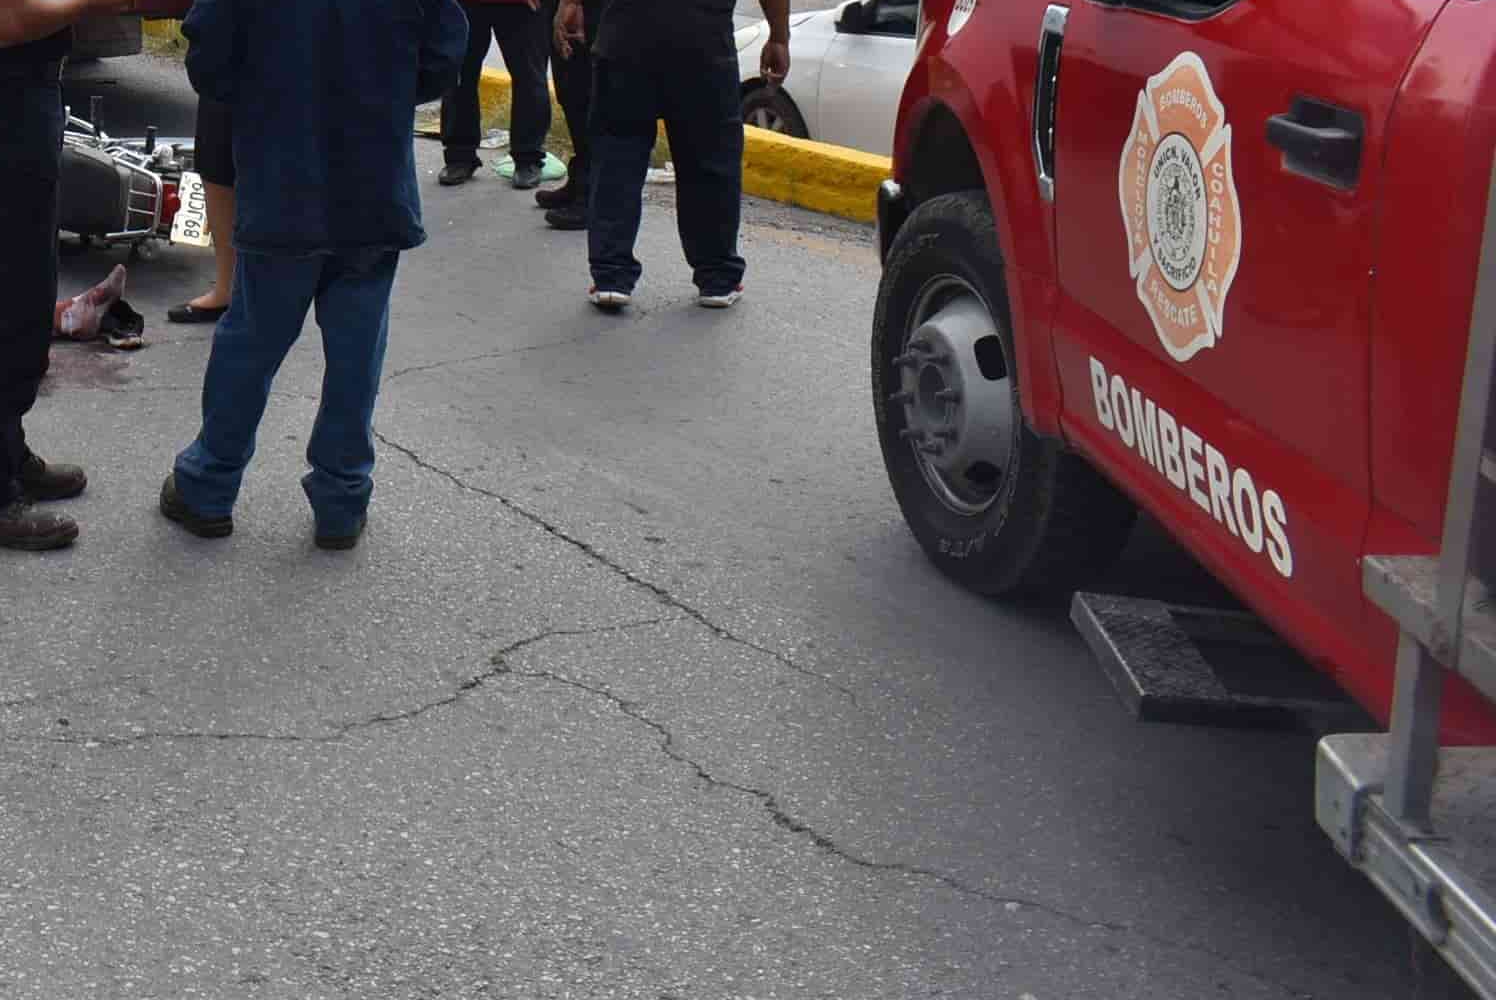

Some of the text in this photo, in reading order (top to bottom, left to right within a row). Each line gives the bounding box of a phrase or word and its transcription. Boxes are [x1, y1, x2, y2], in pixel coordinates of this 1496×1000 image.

[1160, 87, 1208, 129] BOMBEROS
[1208, 162, 1224, 296] COAHUILA
[1089, 355, 1293, 577] BOMBEROS
